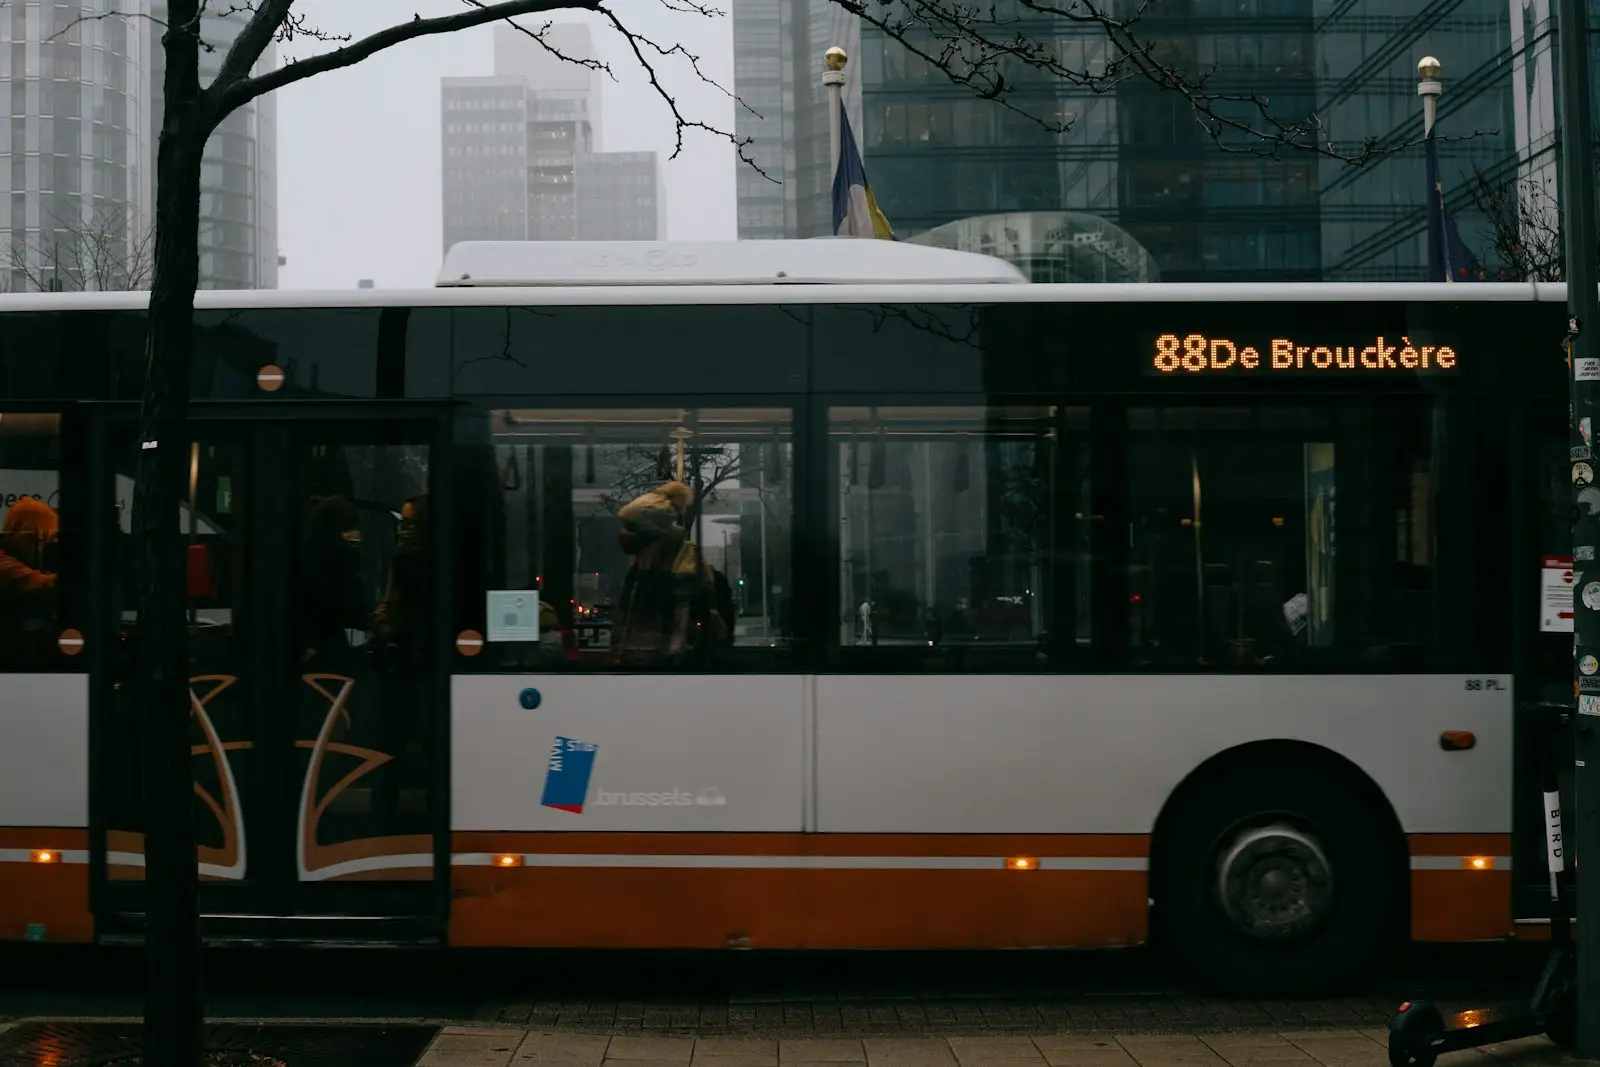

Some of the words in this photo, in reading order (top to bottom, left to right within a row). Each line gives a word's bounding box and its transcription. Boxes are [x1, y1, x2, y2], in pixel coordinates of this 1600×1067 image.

[1154, 334, 1207, 372] 88
[1210, 339, 1259, 369] De
[1272, 336, 1456, 369] Brouckère
[1464, 679, 1482, 691] 88
[1551, 810, 1563, 858] BIRD
